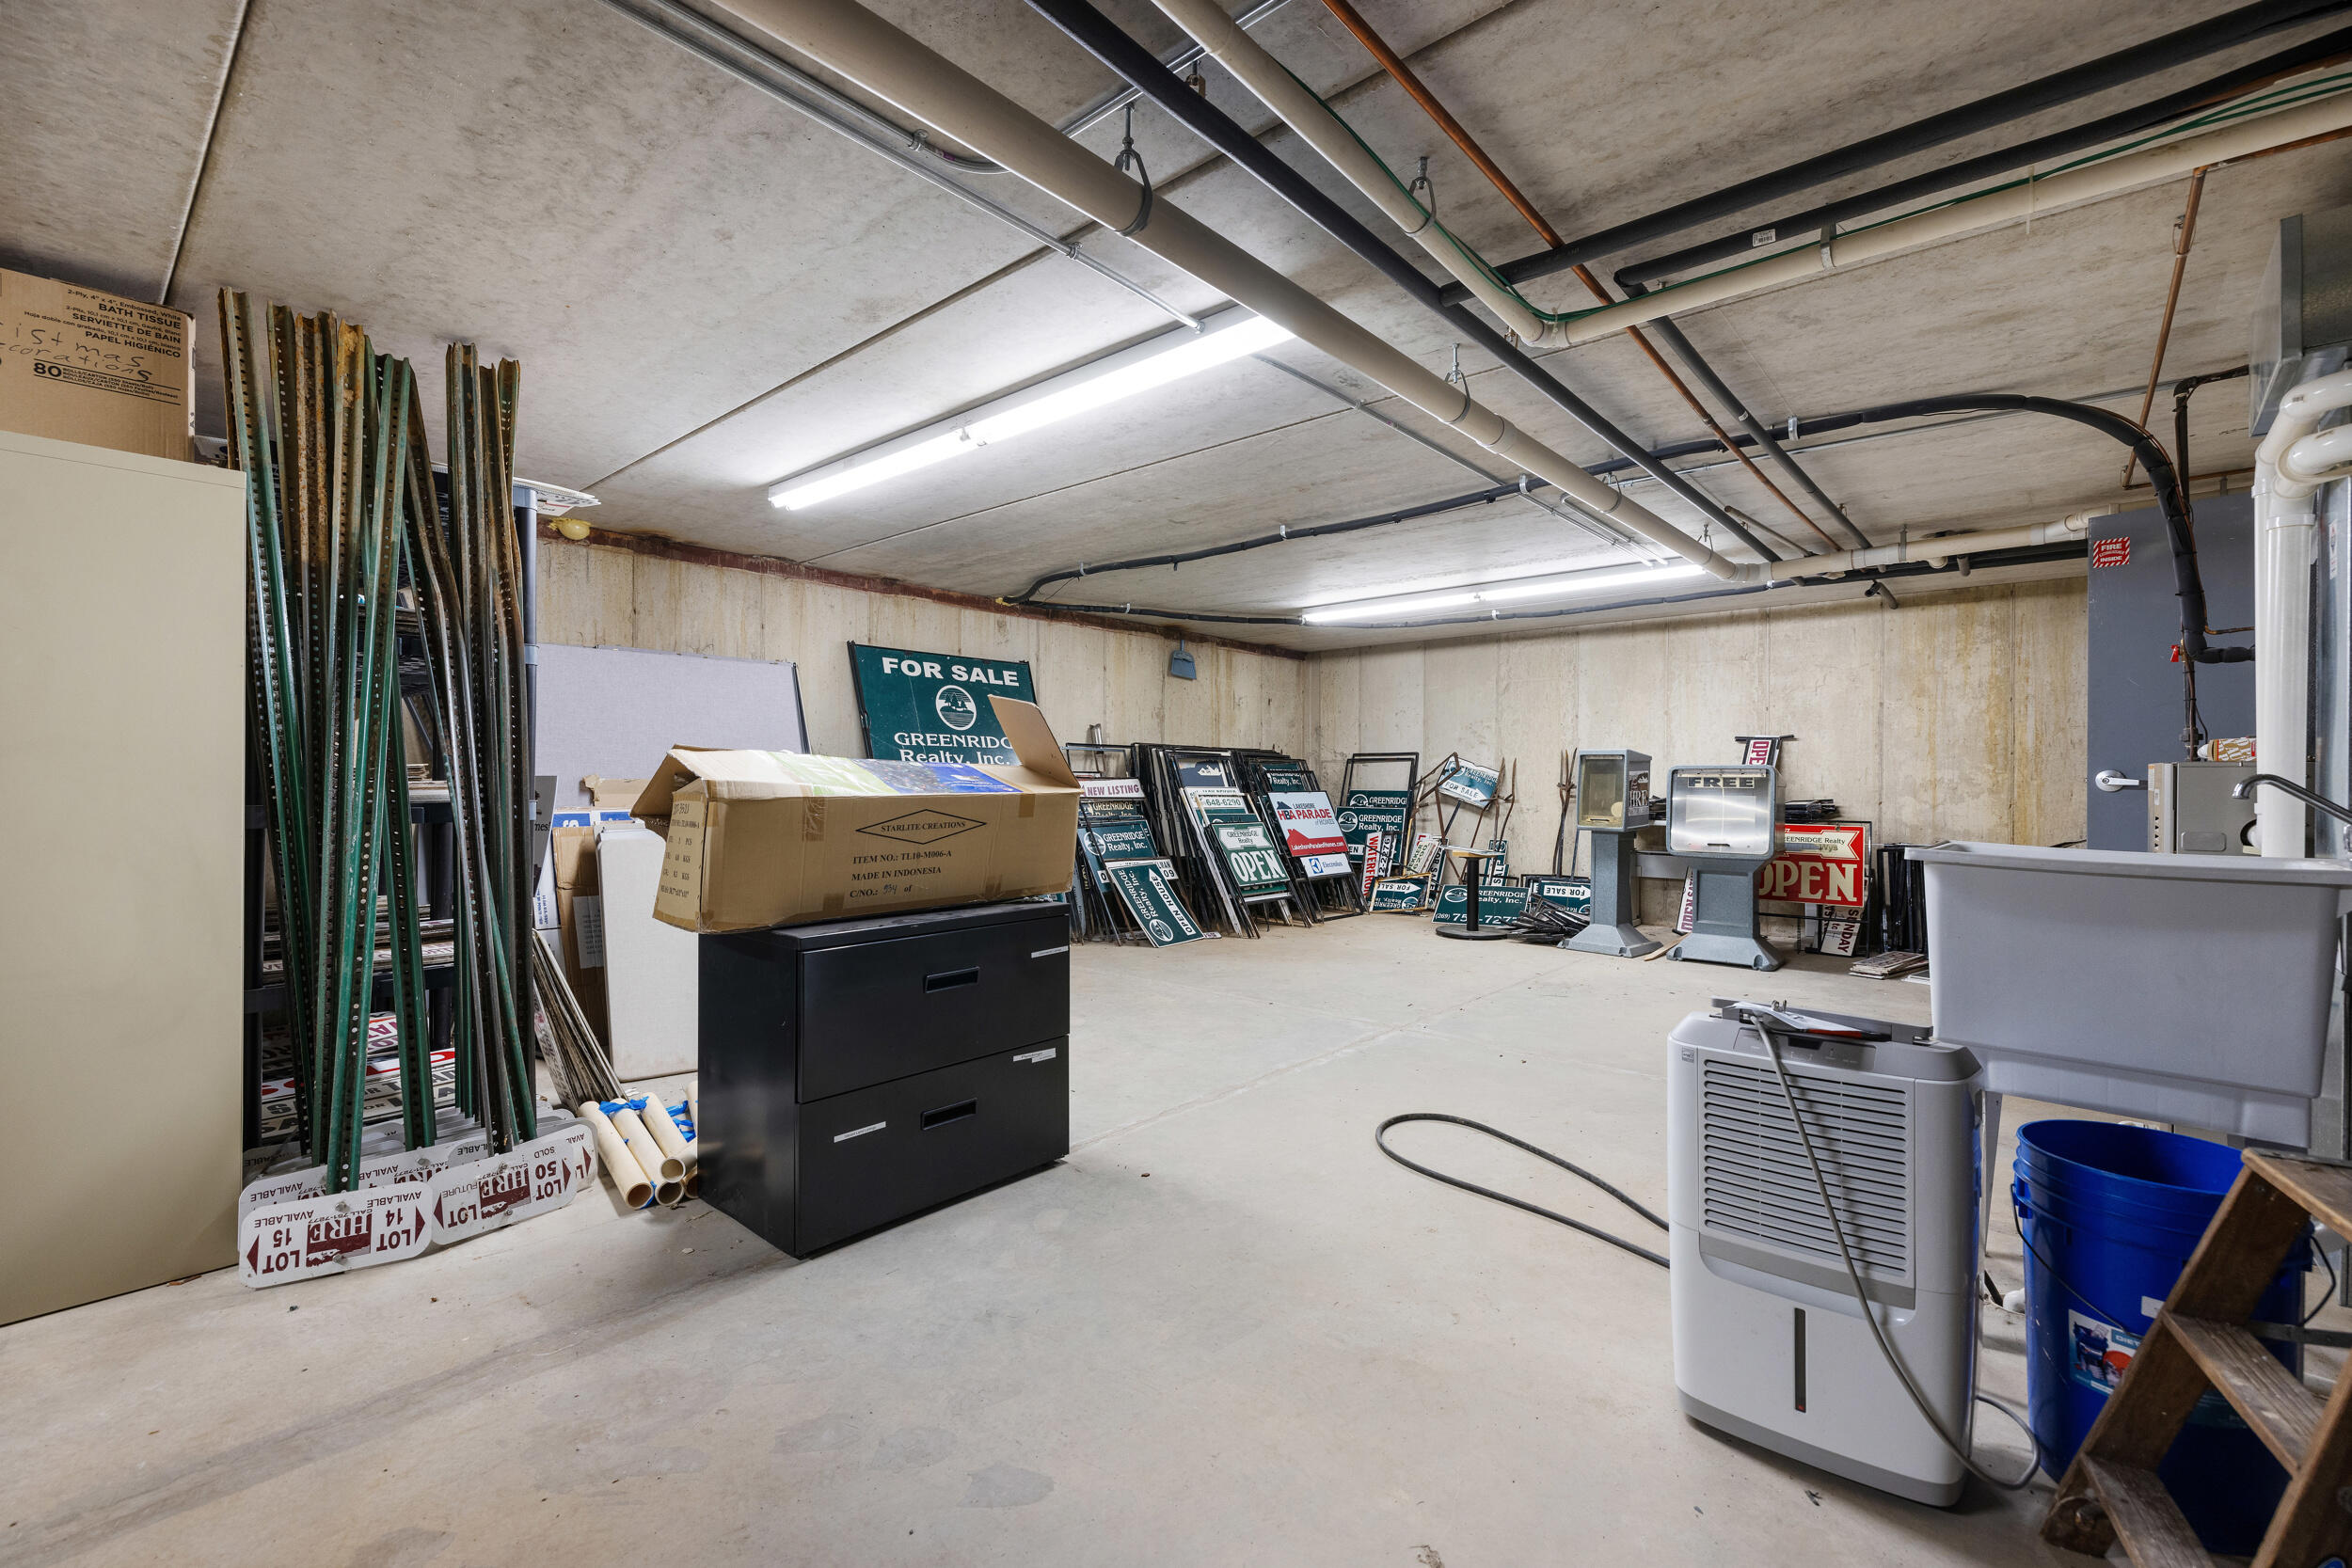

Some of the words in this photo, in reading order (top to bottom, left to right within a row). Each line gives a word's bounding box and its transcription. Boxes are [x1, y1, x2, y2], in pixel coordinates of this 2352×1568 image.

[99, 303, 133, 317] BATH
[137, 312, 181, 329] TISSUE
[72, 313, 134, 332] SERVIETTE
[137, 328, 151, 337] DE
[155, 331, 181, 344] BAIN
[86, 331, 121, 344] PAPEL
[124, 340, 181, 357] HIGIÉNICO
[0, 342, 152, 382] corations
[34, 362, 62, 377] 80
[882, 657, 944, 679] FOR
[951, 665, 1020, 687] SALE
[894, 733, 1012, 749] GREENRIDG
[899, 749, 971, 764] Realty,
[977, 752, 1009, 765] Inc.
[1749, 741, 1769, 765] OPE
[1087, 786, 1104, 797] NEW
[1107, 784, 1139, 795] LISTING
[1445, 782, 1458, 790] FOR
[1461, 787, 1478, 798] SALE
[1689, 777, 1754, 787] FREE
[1092, 801, 1134, 810] GREENRIDGE
[1277, 809, 1296, 820] HBA
[1295, 809, 1332, 819] PARADE
[922, 822, 966, 831] CREATIONS
[1359, 814, 1403, 823] GREENRIDGE
[1359, 823, 1384, 832] Realty,
[1103, 831, 1145, 842] GREENRIDGE
[1106, 841, 1134, 851] Realty,
[852, 855, 878, 864] ITEM
[1231, 849, 1286, 882] OPEN
[1363, 835, 1379, 896] WATERFRON
[1379, 838, 1391, 874] 2-2276
[851, 872, 879, 881] MADE
[882, 870, 891, 879] IN
[894, 866, 942, 877] INDONESIA
[850, 889, 879, 898] C/NO.:
[903, 884, 914, 893] of
[1118, 870, 1151, 919] GREENRIDGE
[1151, 875, 1174, 906] HOUSE
[1137, 888, 1158, 917] Realty,
[1173, 910, 1192, 933] OPEN
[534, 1146, 555, 1159] SOLD
[358, 1164, 399, 1180] AVAILAB
[535, 1161, 557, 1180] 50
[250, 1181, 303, 1201] AVAILABLE
[442, 1182, 477, 1197] FUTURE
[482, 1168, 529, 1197] HRE
[535, 1179, 562, 1201] LOT
[367, 1191, 421, 1209] AVAILABLE
[254, 1210, 314, 1228] AVAILABLE
[386, 1208, 403, 1227] 14
[448, 1204, 477, 1228] LOT
[273, 1227, 292, 1248] 15
[309, 1213, 372, 1243] HRE
[376, 1228, 410, 1252] LOT
[262, 1249, 300, 1275] LOT
